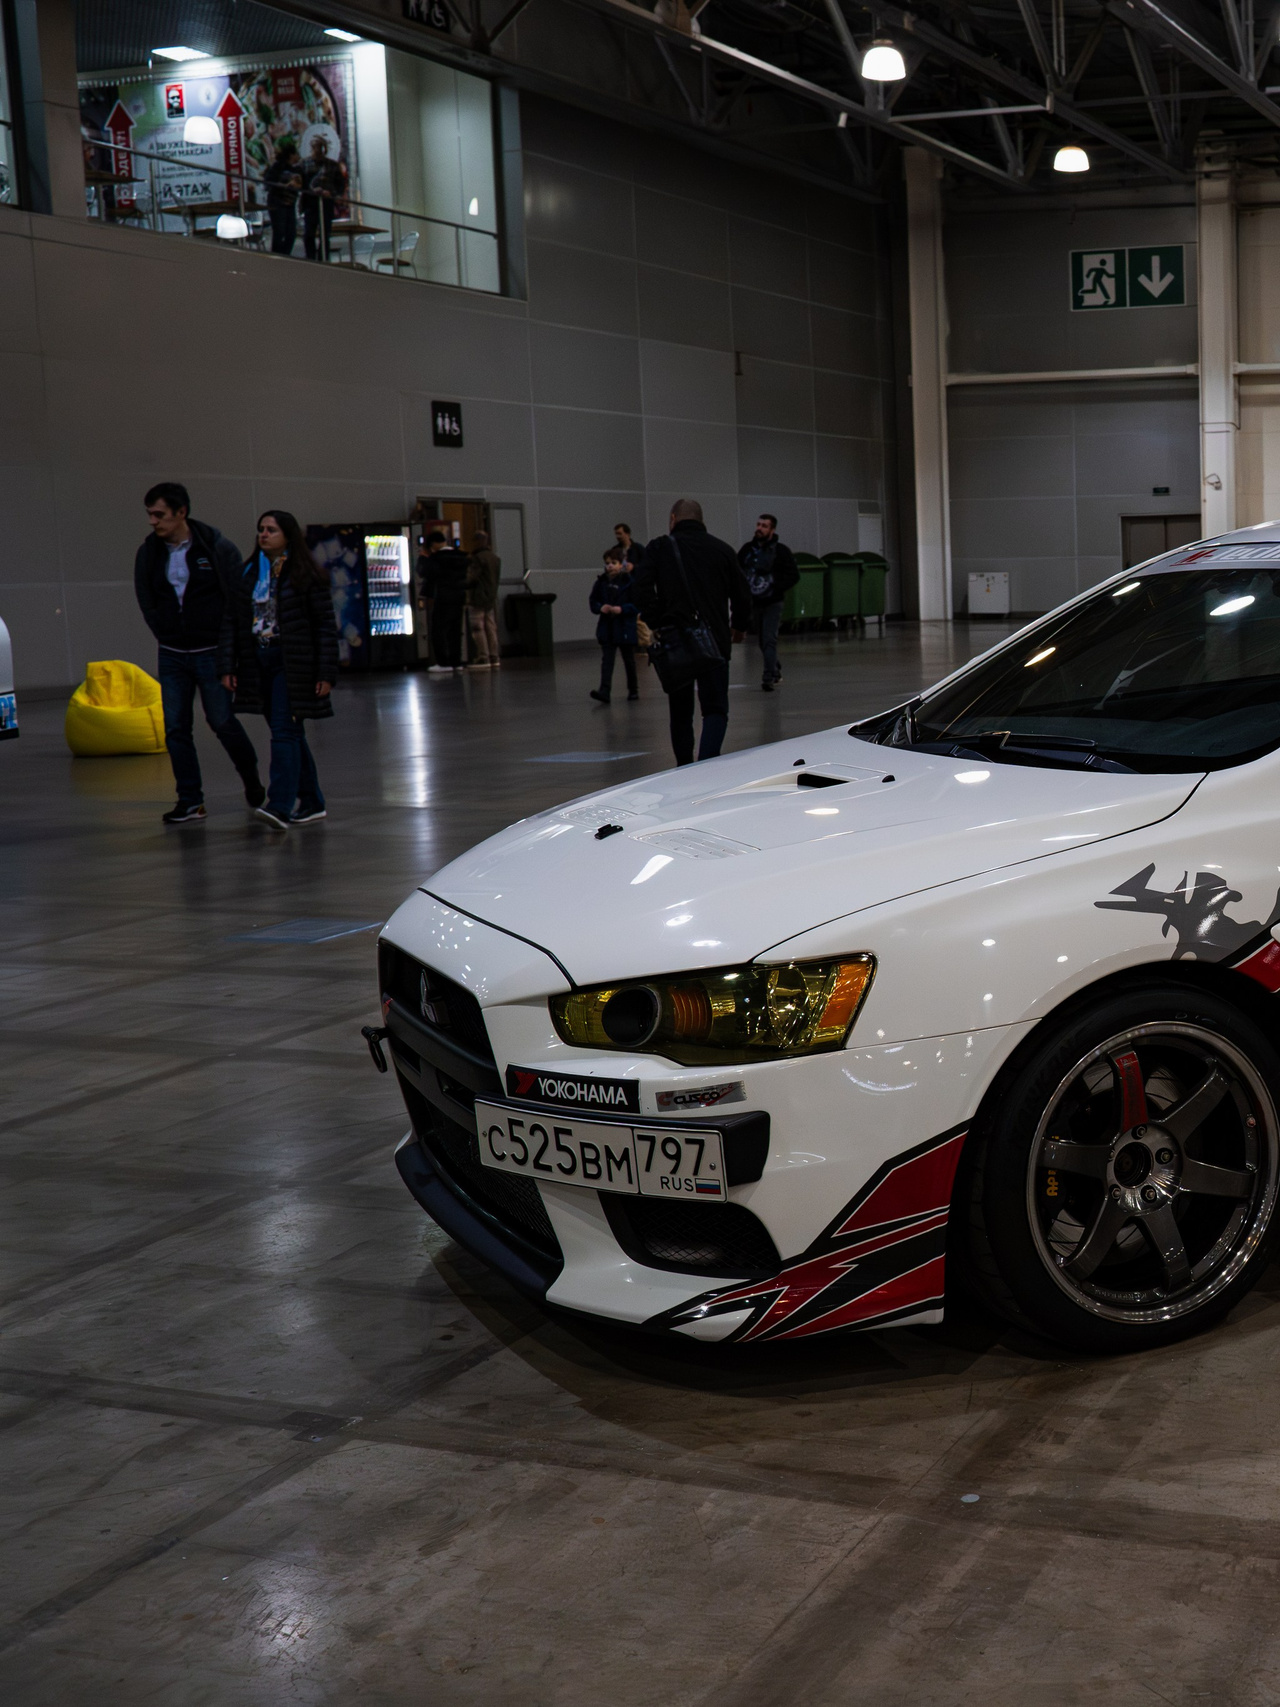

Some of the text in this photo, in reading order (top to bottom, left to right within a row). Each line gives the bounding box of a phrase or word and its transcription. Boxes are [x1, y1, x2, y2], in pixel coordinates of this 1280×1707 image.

[227, 116, 239, 165] ПРЯМО!
[537, 1077, 629, 1106] YOKOHAMA
[637, 1134, 706, 1176] 797
[660, 1176, 695, 1193] RUS
